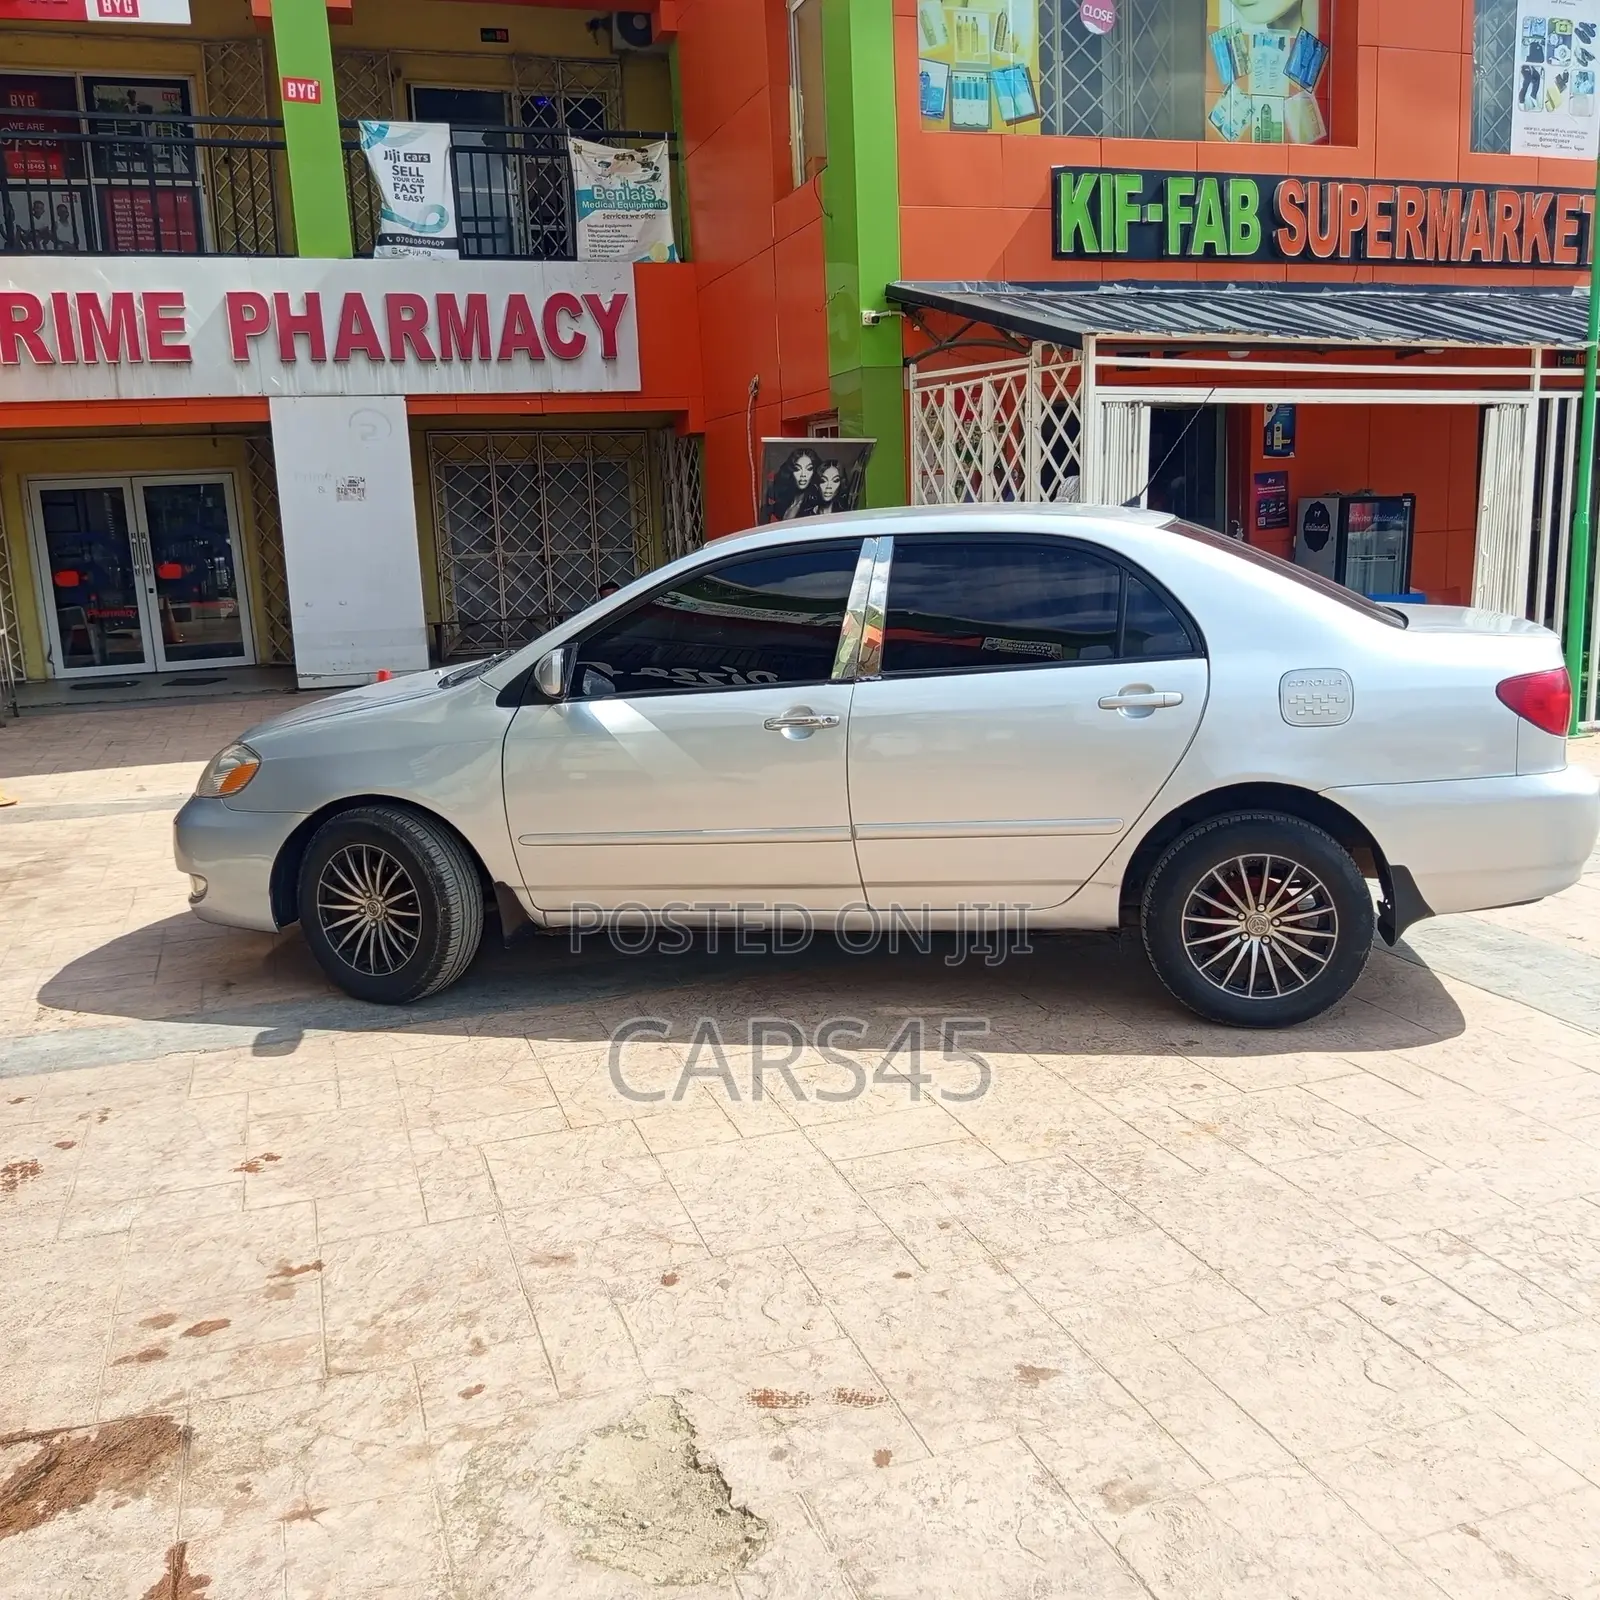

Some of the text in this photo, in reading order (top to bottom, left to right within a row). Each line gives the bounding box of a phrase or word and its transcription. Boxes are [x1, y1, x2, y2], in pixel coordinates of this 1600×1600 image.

[1083, 4, 1113, 23] CLOSE
[287, 81, 316, 100] BYC
[9, 122, 45, 131] WE ARE
[384, 149, 430, 164] Jiji cars
[392, 165, 424, 178] SELL
[393, 183, 425, 195] FAST
[403, 194, 425, 202] EASY
[582, 200, 667, 212] Medical Equipments
[1057, 172, 1262, 257] KIF-FAB
[0, 291, 629, 364] RIME PHARMACY
[1288, 679, 1342, 687] COROLLA
